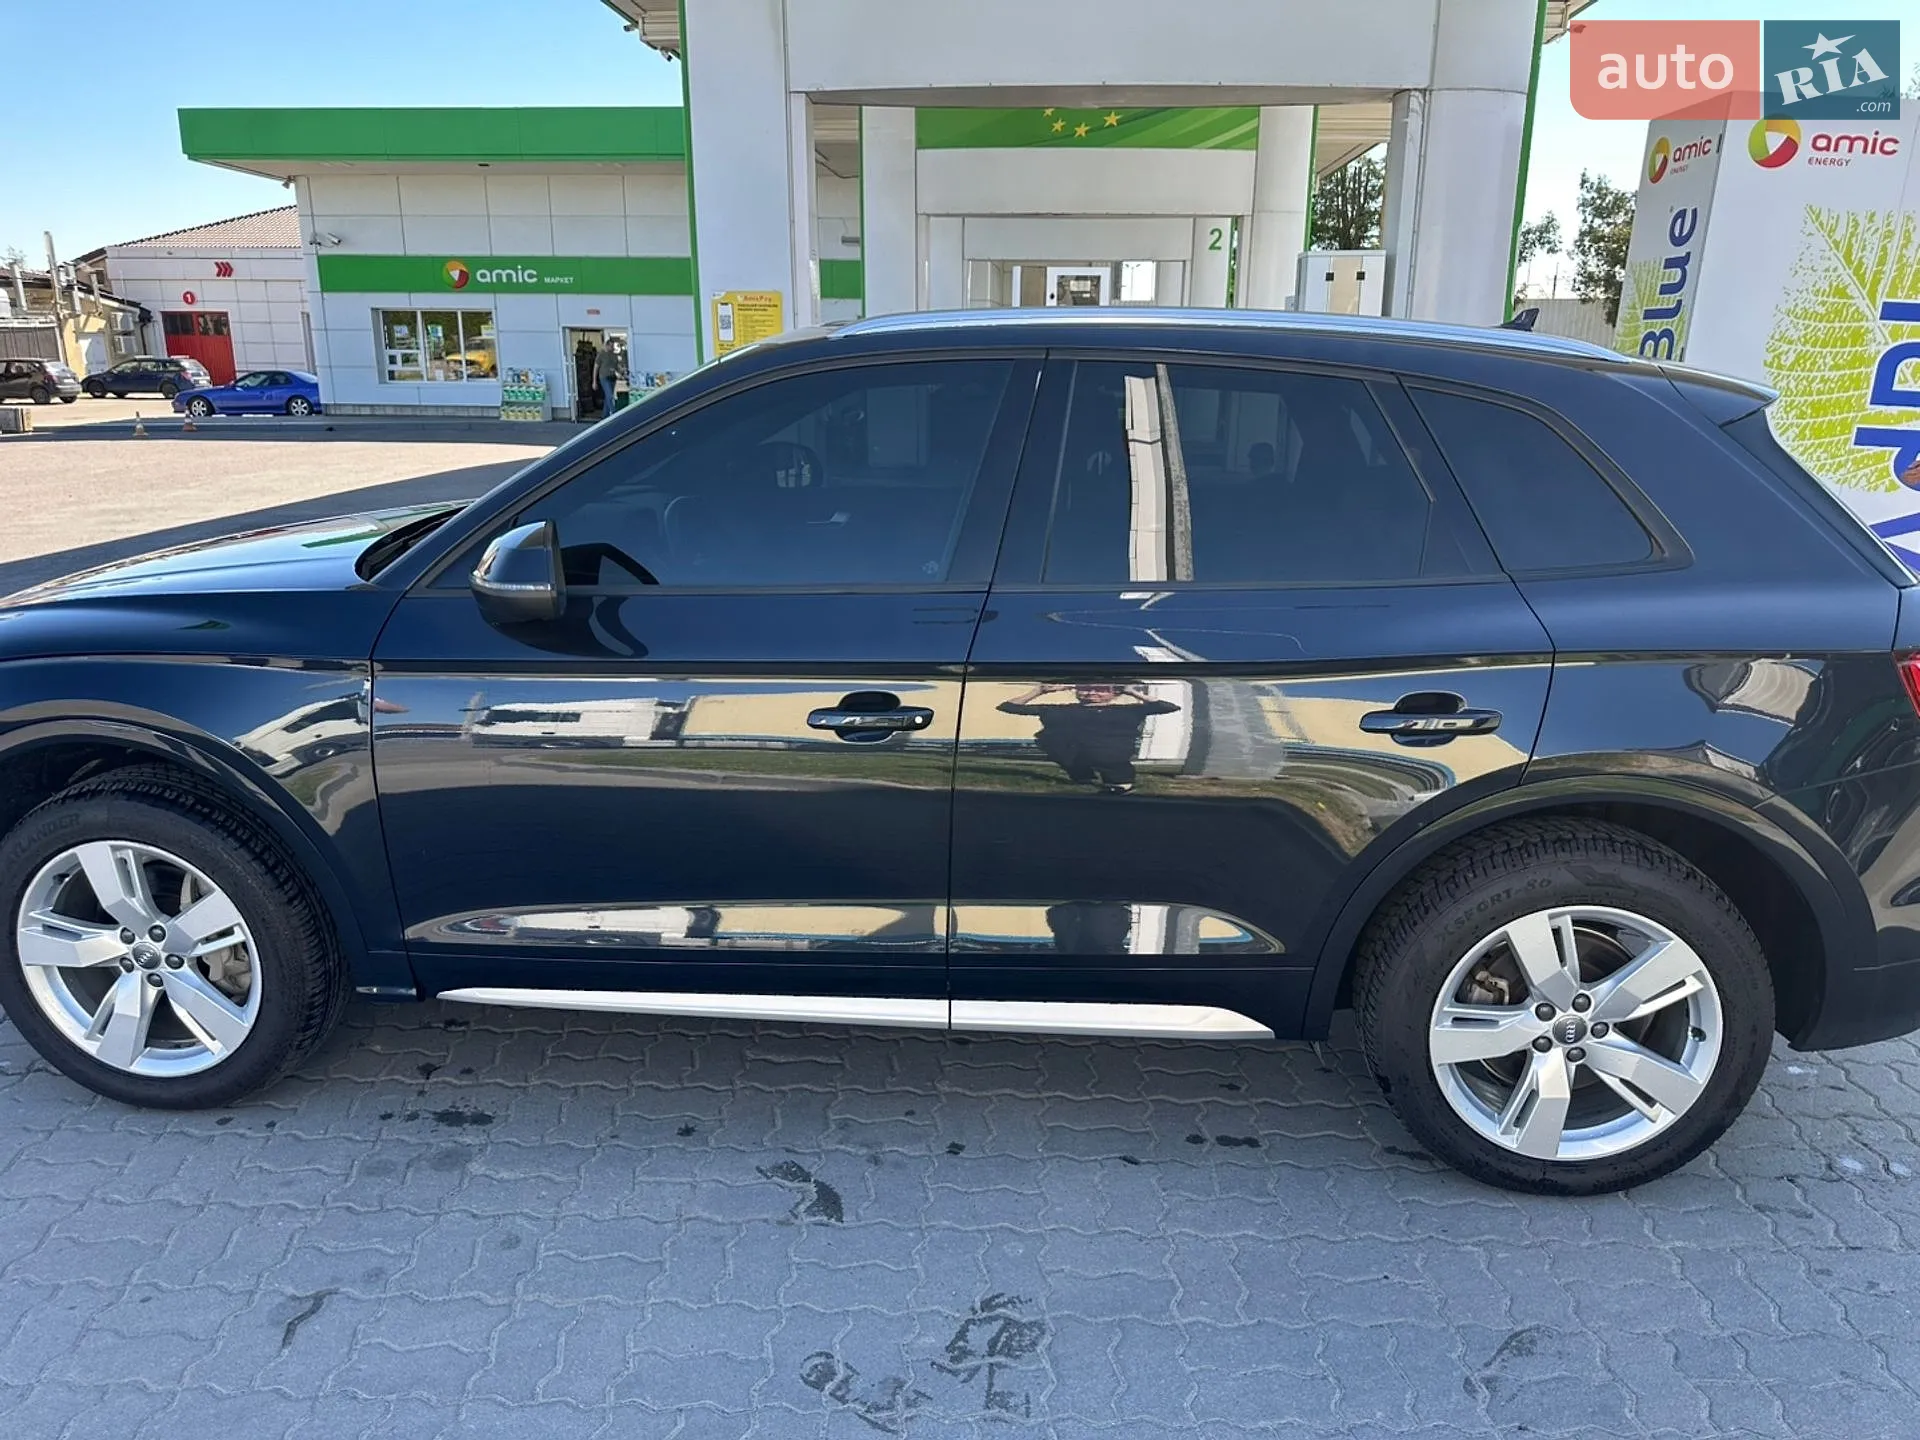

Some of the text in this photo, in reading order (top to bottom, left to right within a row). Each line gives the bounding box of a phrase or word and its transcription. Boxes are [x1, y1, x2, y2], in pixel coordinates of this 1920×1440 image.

[1673, 135, 1712, 162] amic
[1811, 130, 1900, 156] amic
[1807, 156, 1851, 167] ENERGY
[1208, 228, 1223, 250] 2
[475, 265, 538, 284] amic
